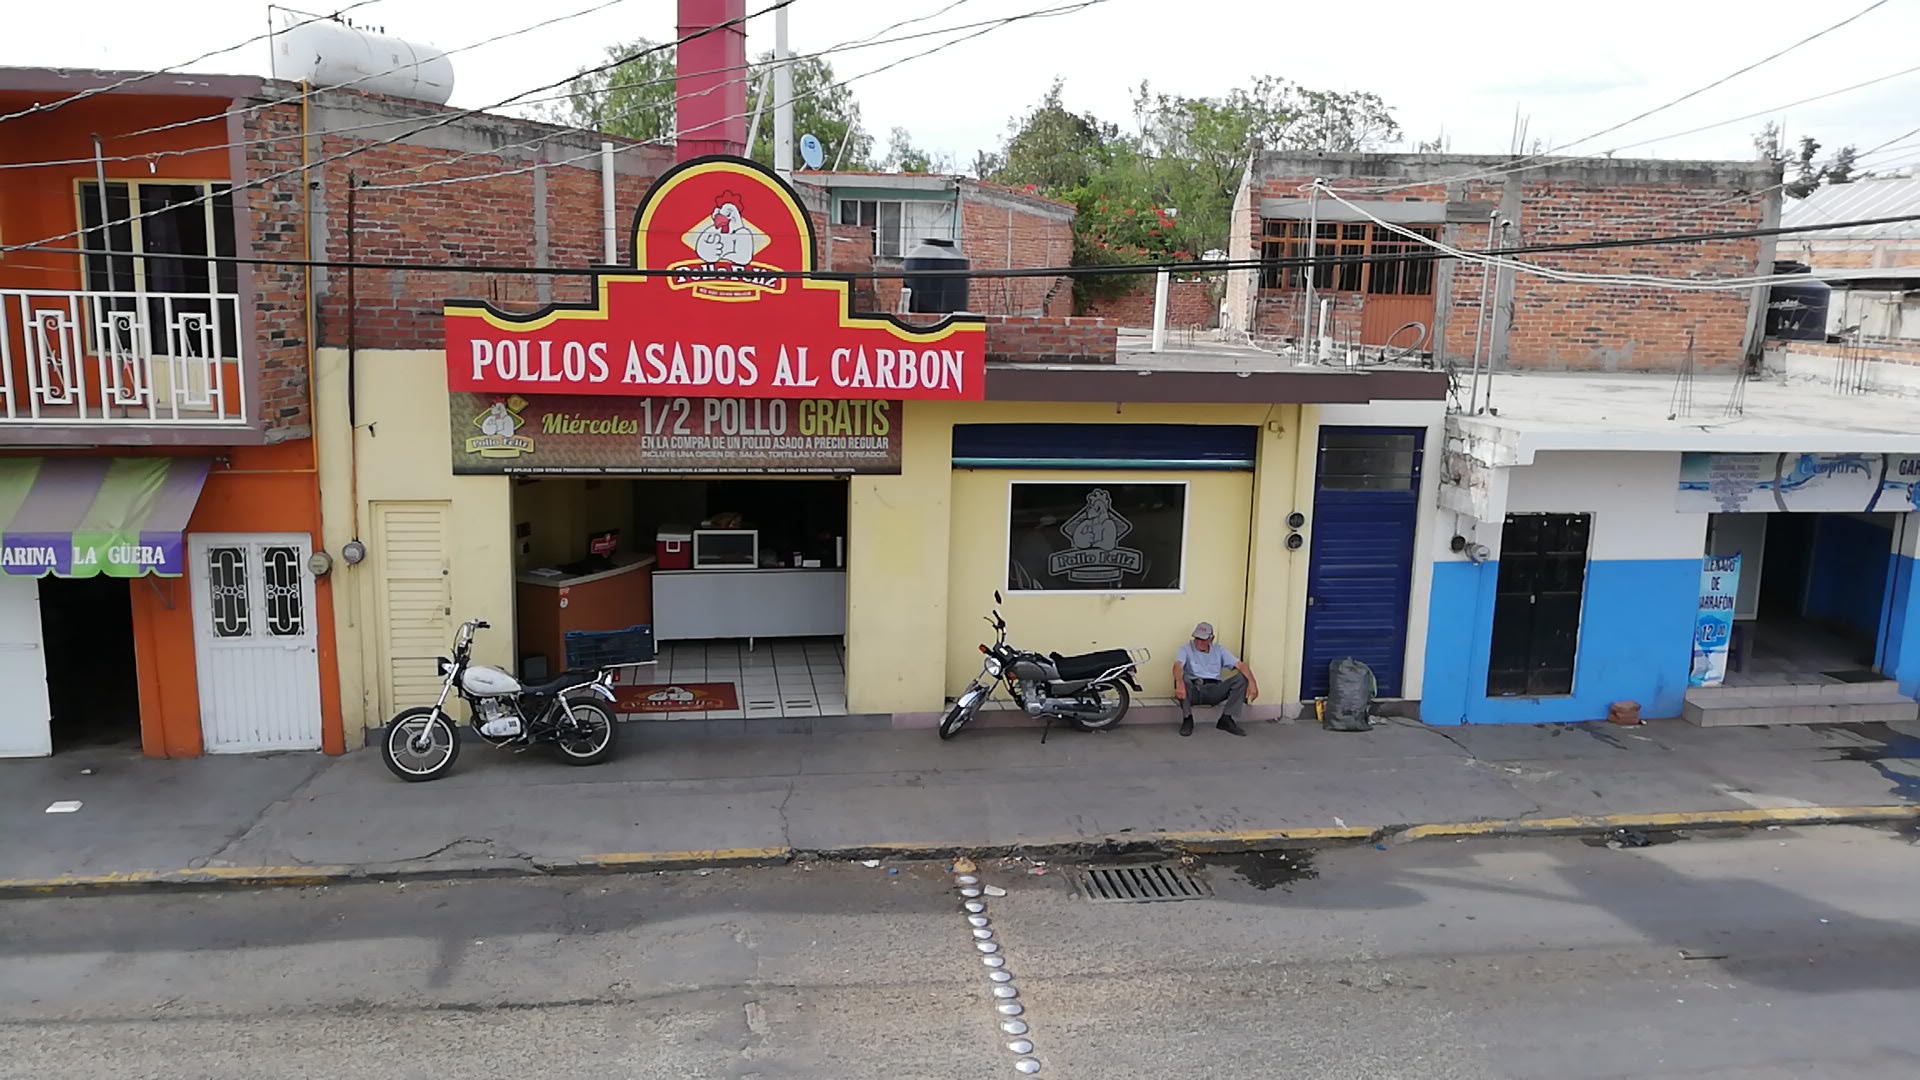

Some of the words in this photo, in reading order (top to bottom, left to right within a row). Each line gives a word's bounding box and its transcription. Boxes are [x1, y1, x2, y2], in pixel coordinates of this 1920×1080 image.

[470, 339, 609, 383] POLLOS
[621, 339, 758, 387] ASADOS
[771, 343, 819, 387] AL
[831, 344, 964, 394] CARBON
[541, 413, 638, 435] Miércoles
[640, 397, 691, 435] 1/2
[704, 398, 787, 436] POLLO
[799, 399, 890, 436] GRATIS
[641, 436, 655, 449] EN
[656, 436, 669, 449] LA
[671, 436, 711, 449] COMPRA
[712, 436, 726, 449] DE
[727, 437, 740, 449] UN
[742, 437, 771, 449] POLLO
[773, 437, 804, 449] ASADO
[805, 437, 813, 449] A
[814, 437, 847, 449] PRECIO
[848, 437, 889, 449] REGULAR
[0, 546, 57, 566] ARINA
[73, 547, 97, 564] LA
[108, 542, 166, 564] GÜERA
[1058, 552, 1096, 567] Pollo
[1704, 559, 1735, 572] LLENADO
[1711, 577, 1721, 590] DE
[1699, 593, 1734, 609] ARRAFÓN
